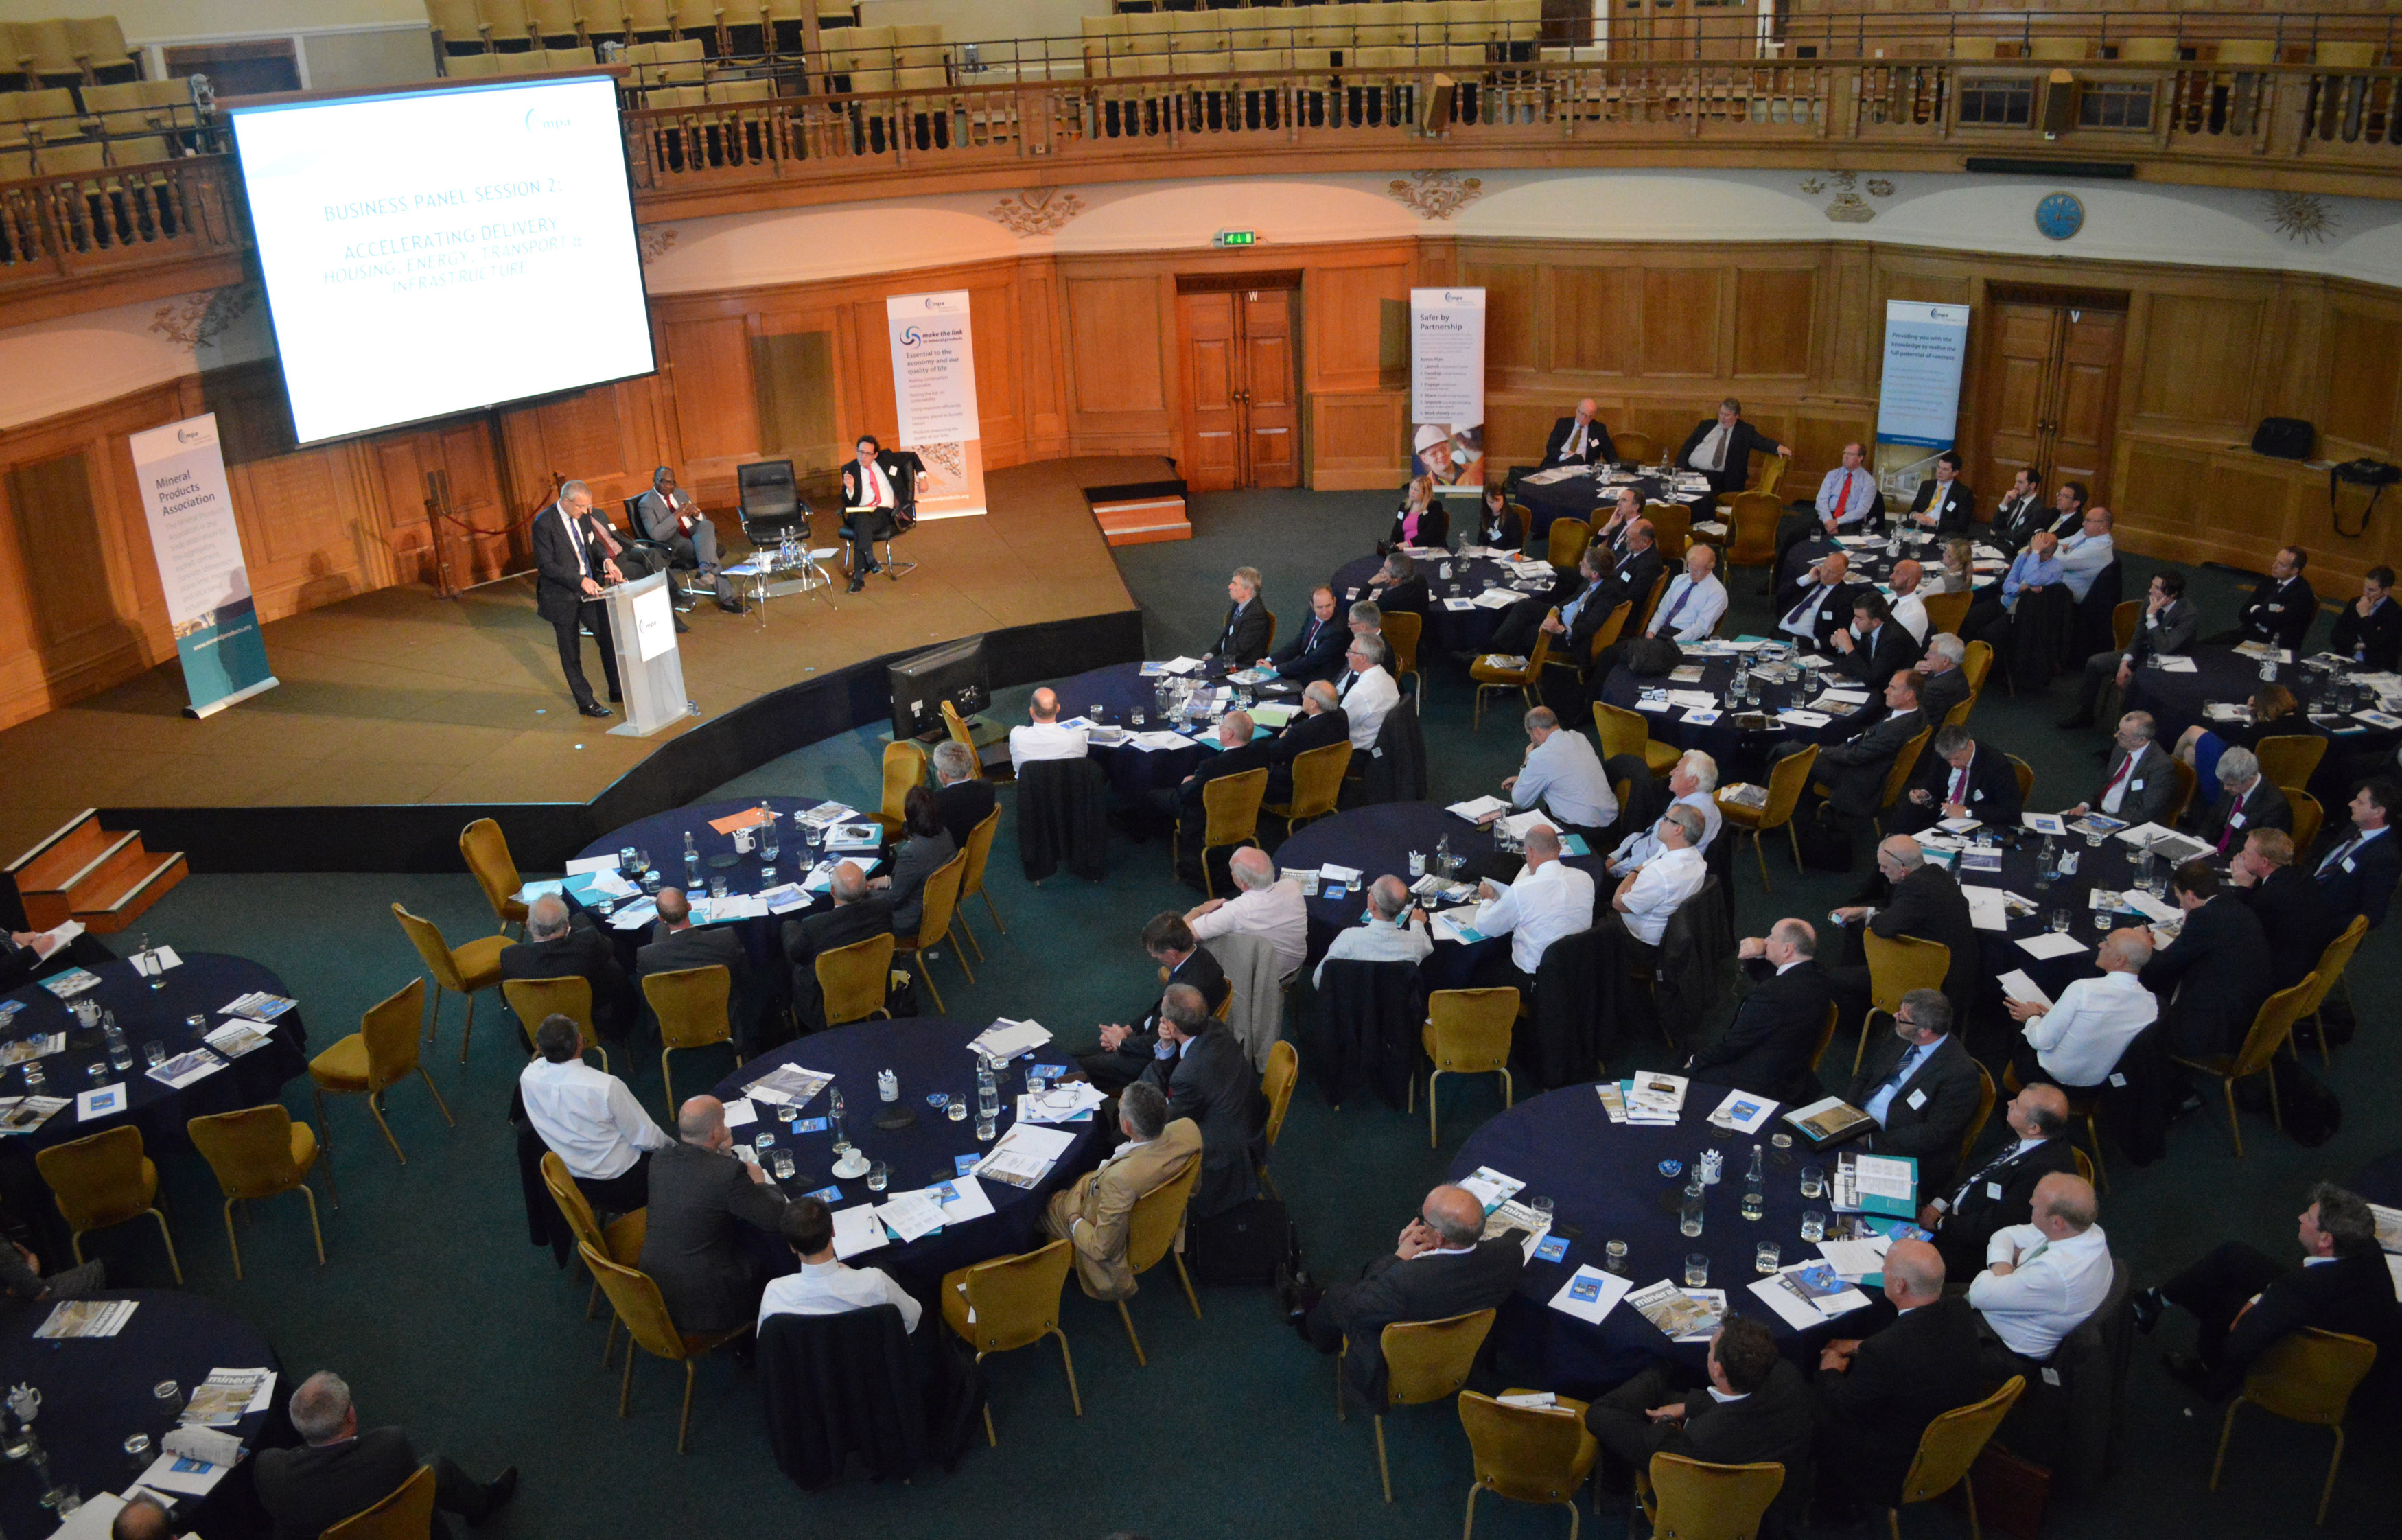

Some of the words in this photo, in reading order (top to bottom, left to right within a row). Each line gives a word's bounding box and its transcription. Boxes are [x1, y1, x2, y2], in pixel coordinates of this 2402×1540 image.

[542, 117, 571, 130] mpa
[324, 196, 408, 222] BUSINESS
[415, 189, 470, 209] PANEL
[475, 180, 541, 202] SESSION
[548, 178, 563, 193] 2:
[345, 228, 475, 260] ACCELERATING
[481, 216, 558, 240] DELIVERY
[482, 235, 568, 260] TRANSPORT
[393, 261, 528, 294] INFRASTRUCTURE
[1249, 291, 1257, 301] W
[1892, 332, 1918, 340] Providing
[906, 351, 933, 359] Essential
[908, 366, 929, 375] quality
[185, 431, 198, 440] mpa
[156, 469, 191, 489] Mineral
[159, 483, 200, 503] Products
[163, 493, 215, 516] Association
[646, 620, 656, 629] mpa
[1635, 1285, 1678, 1307] mineral
[207, 1375, 257, 1384] mineral
